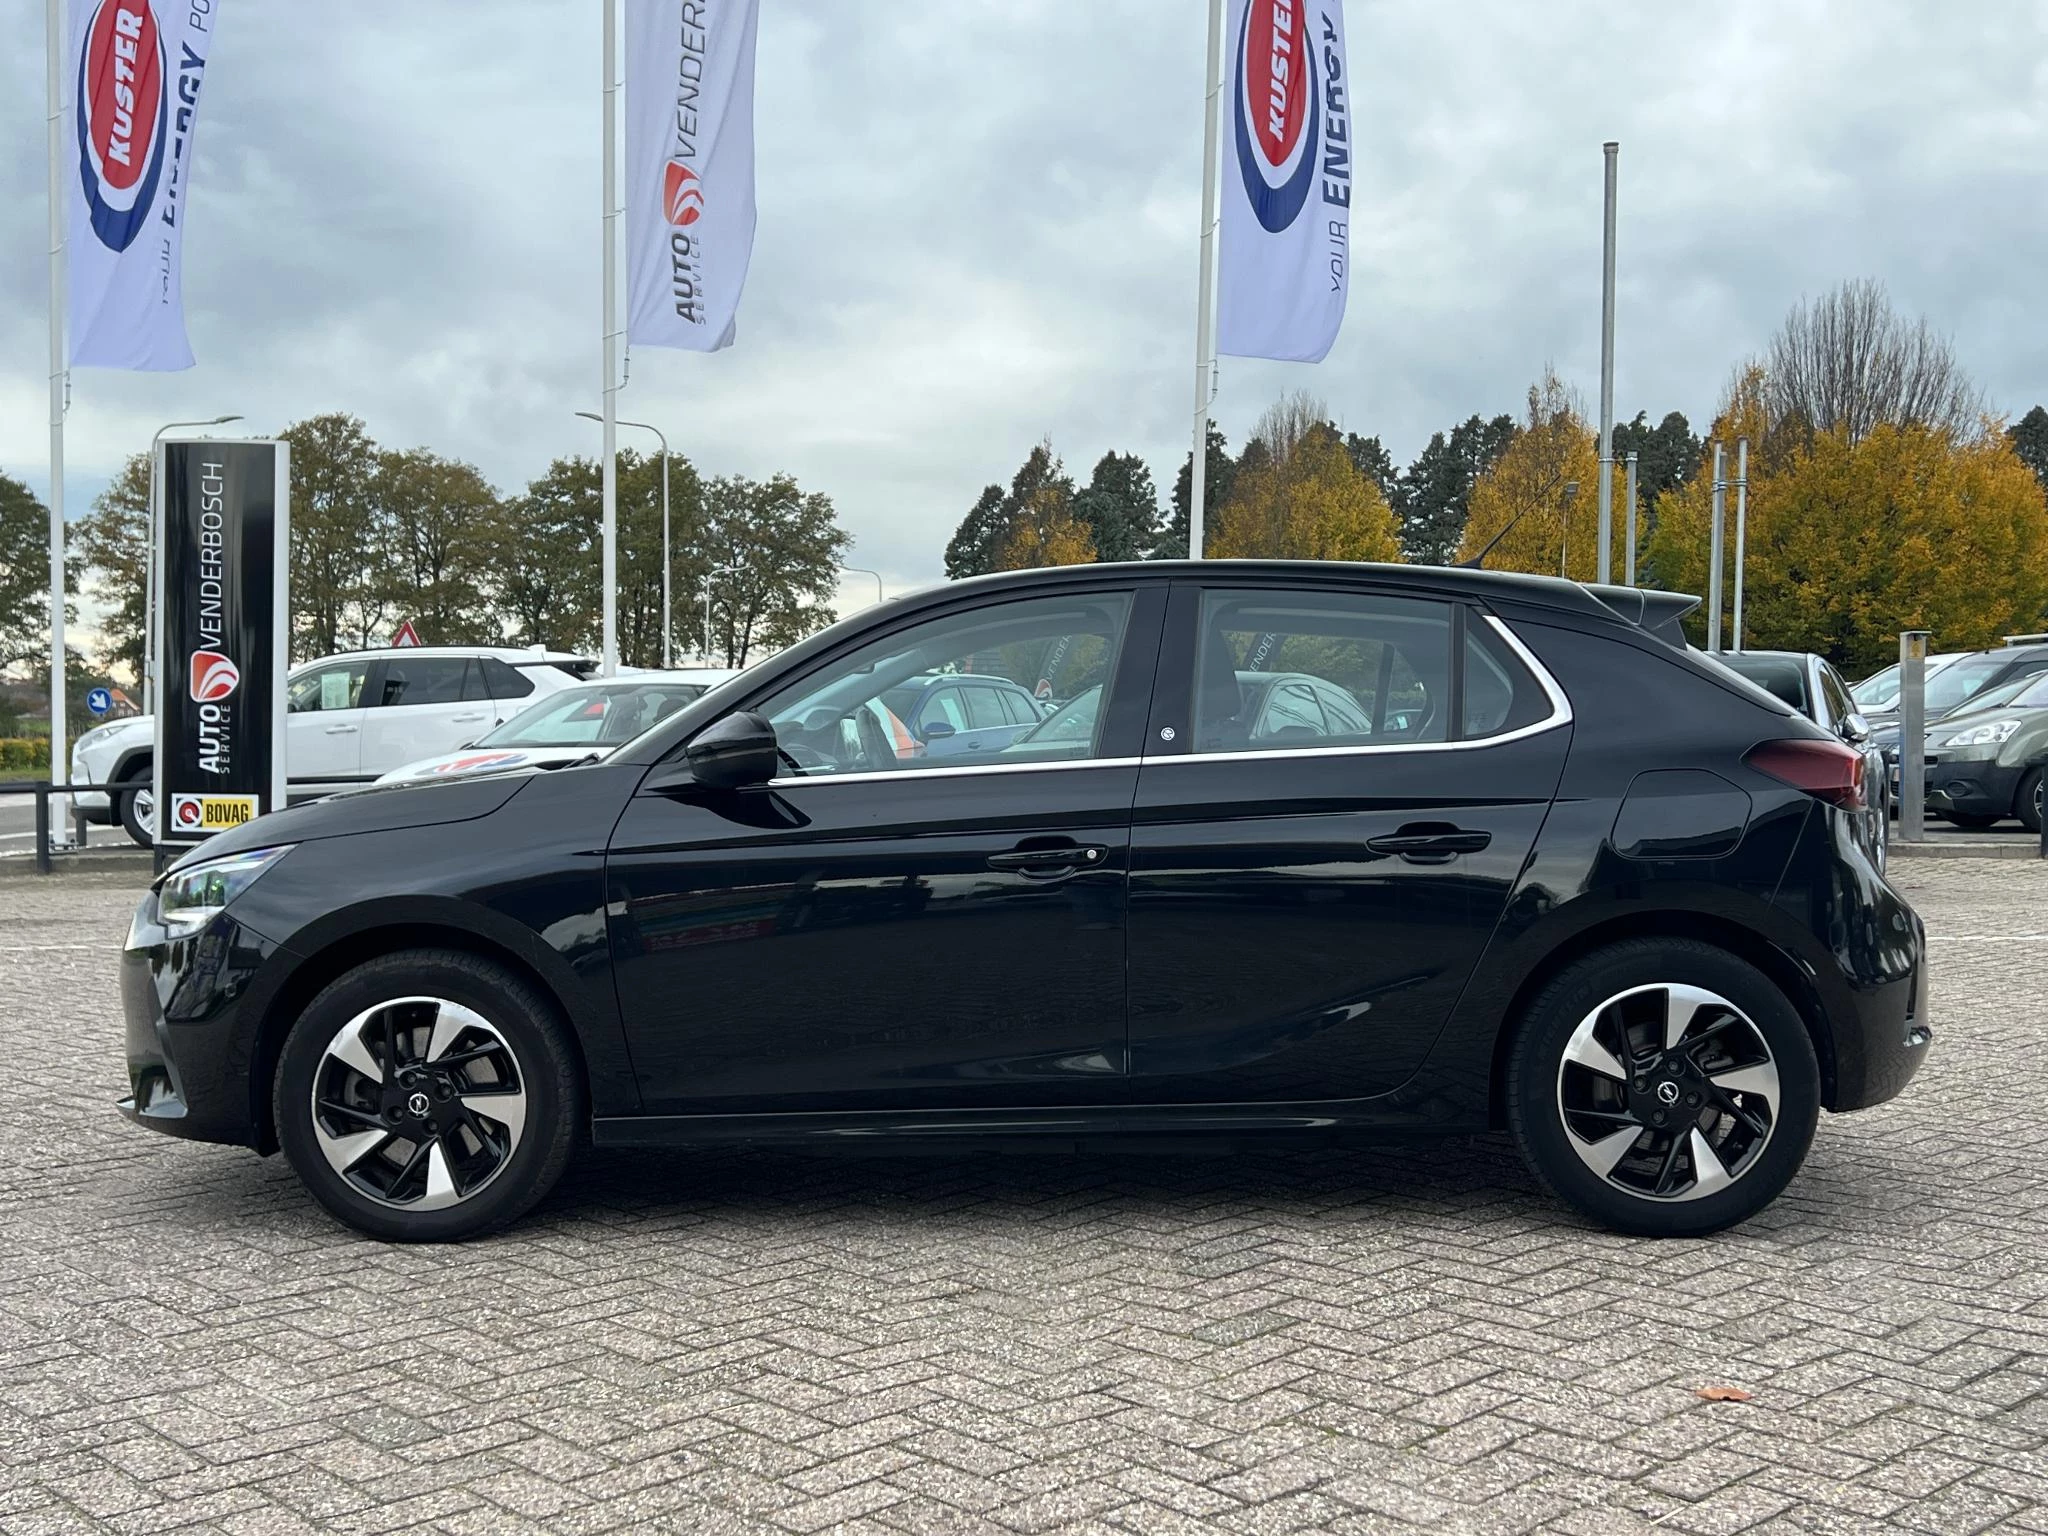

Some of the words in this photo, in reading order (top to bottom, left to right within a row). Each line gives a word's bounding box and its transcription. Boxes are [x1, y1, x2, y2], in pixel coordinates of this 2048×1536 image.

[108, 8, 144, 167] KUSTER
[674, 0, 706, 158] VENDER
[1321, 10, 1352, 209] ENERGY
[161, 40, 206, 229] ERGY
[671, 233, 696, 324] AUTO
[690, 233, 707, 326] SERVICE
[1329, 220, 1347, 292] YOUR
[200, 462, 223, 649] VENDERBOSCH
[1249, 632, 1277, 672] ENDER
[199, 704, 221, 774] AUTO
[220, 704, 231, 774] SERVICE
[205, 803, 249, 824] BOVAG
